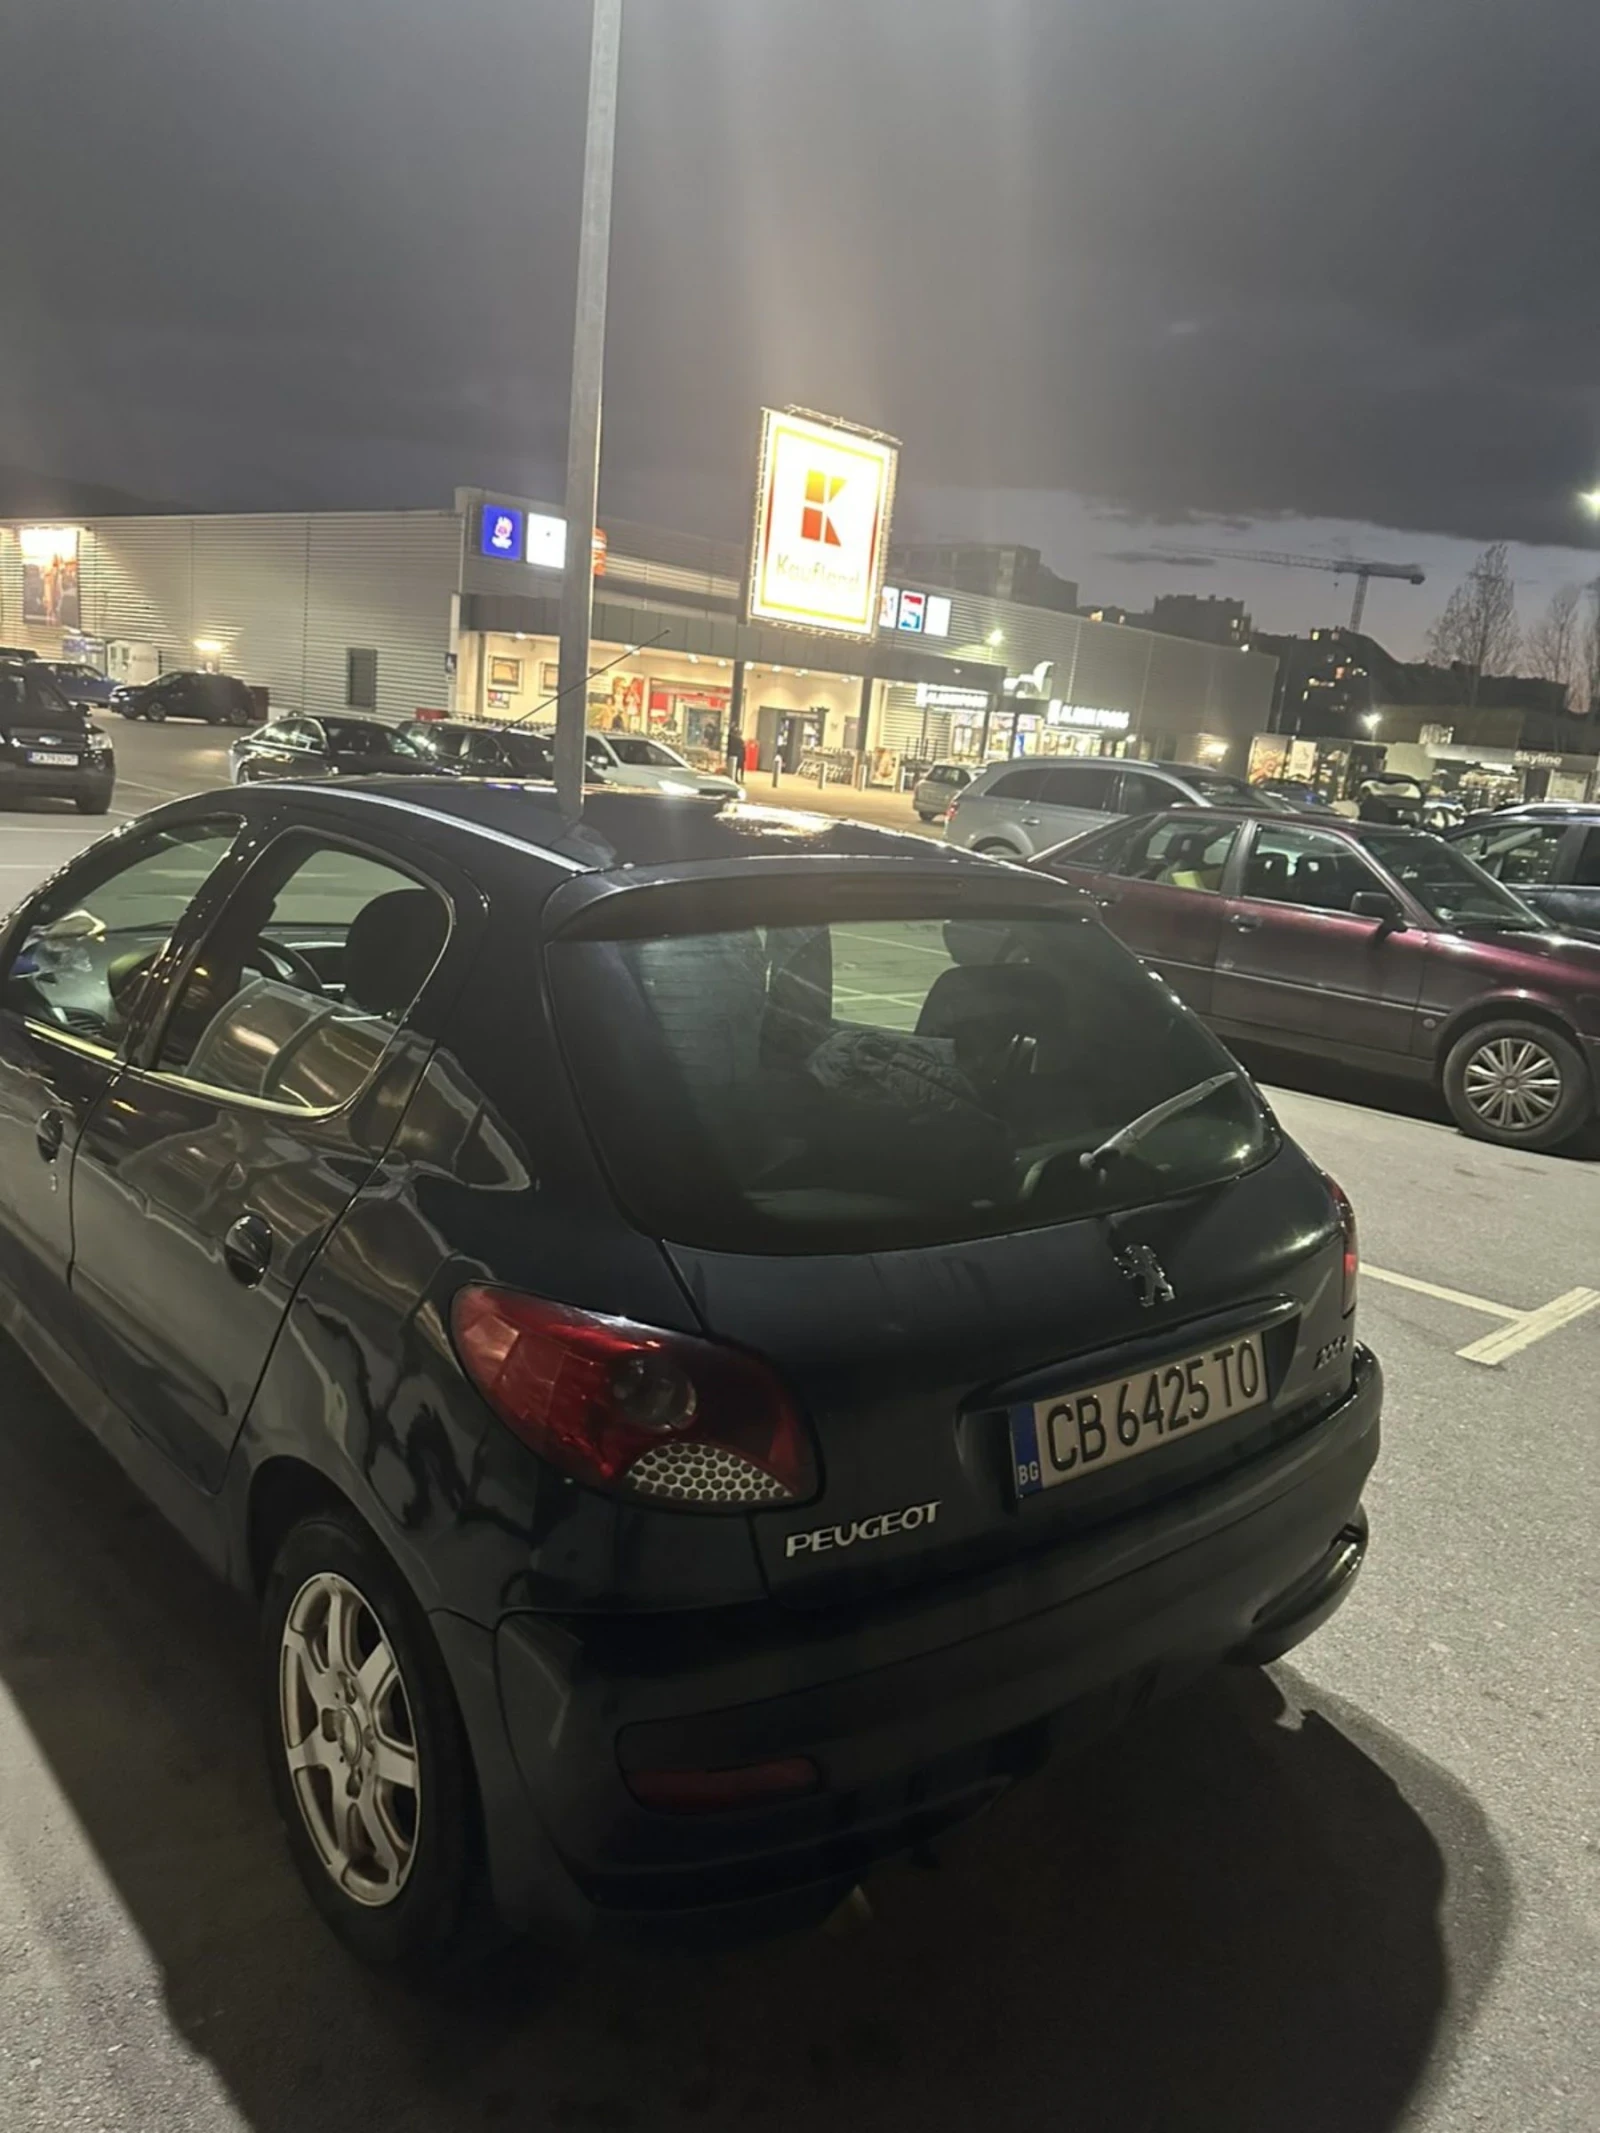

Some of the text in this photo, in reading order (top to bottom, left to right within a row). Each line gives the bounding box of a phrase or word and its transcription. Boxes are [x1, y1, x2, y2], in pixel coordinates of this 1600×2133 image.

[1514, 750, 1562, 767] Skyline
[1047, 1341, 1260, 1472] CB 6425 TO
[1018, 1458, 1040, 1486] BG
[785, 1500, 943, 1558] PEUGEOT
